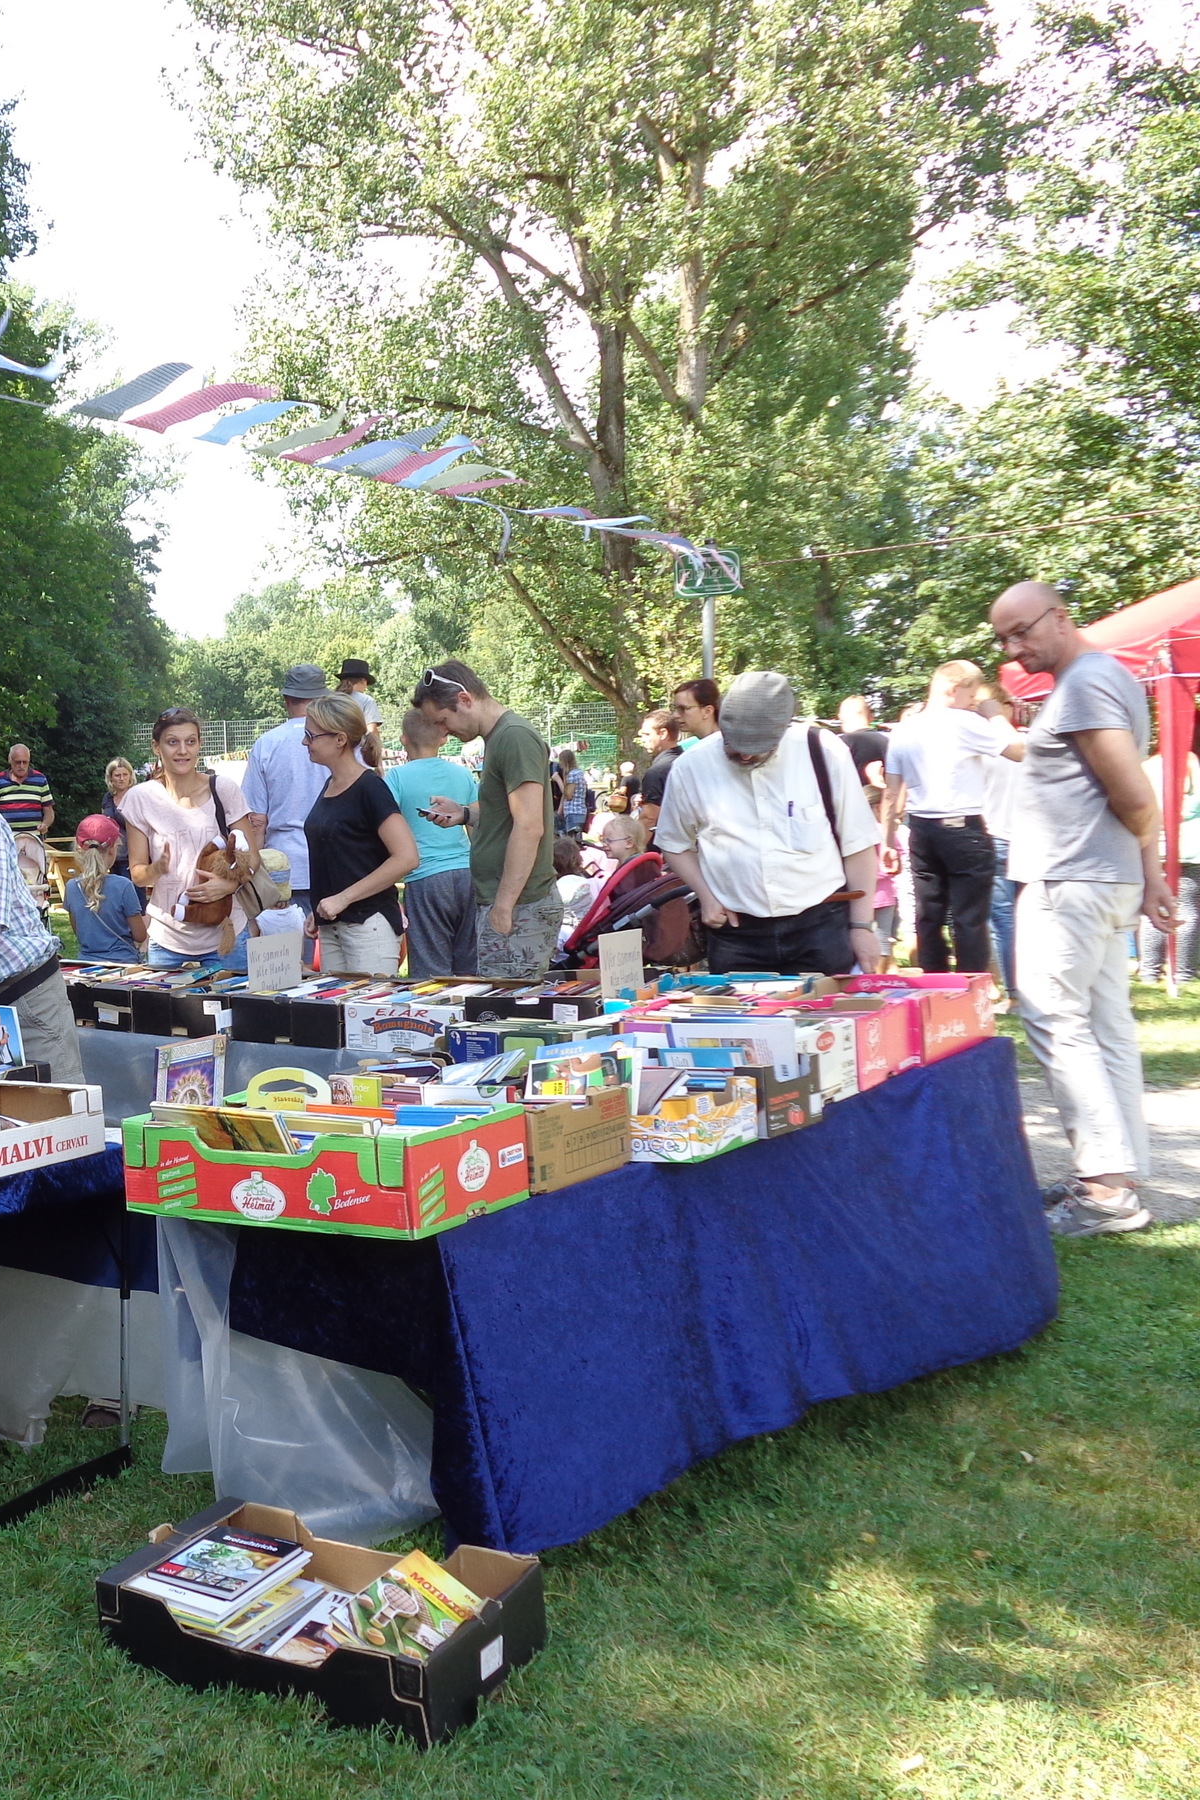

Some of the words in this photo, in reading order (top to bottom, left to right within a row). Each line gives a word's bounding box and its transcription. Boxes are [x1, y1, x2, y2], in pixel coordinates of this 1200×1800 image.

[56, 1135, 89, 1153] CERVATI
[242, 1196, 275, 1211] Heimat
[334, 1194, 371, 1210] Bodensee
